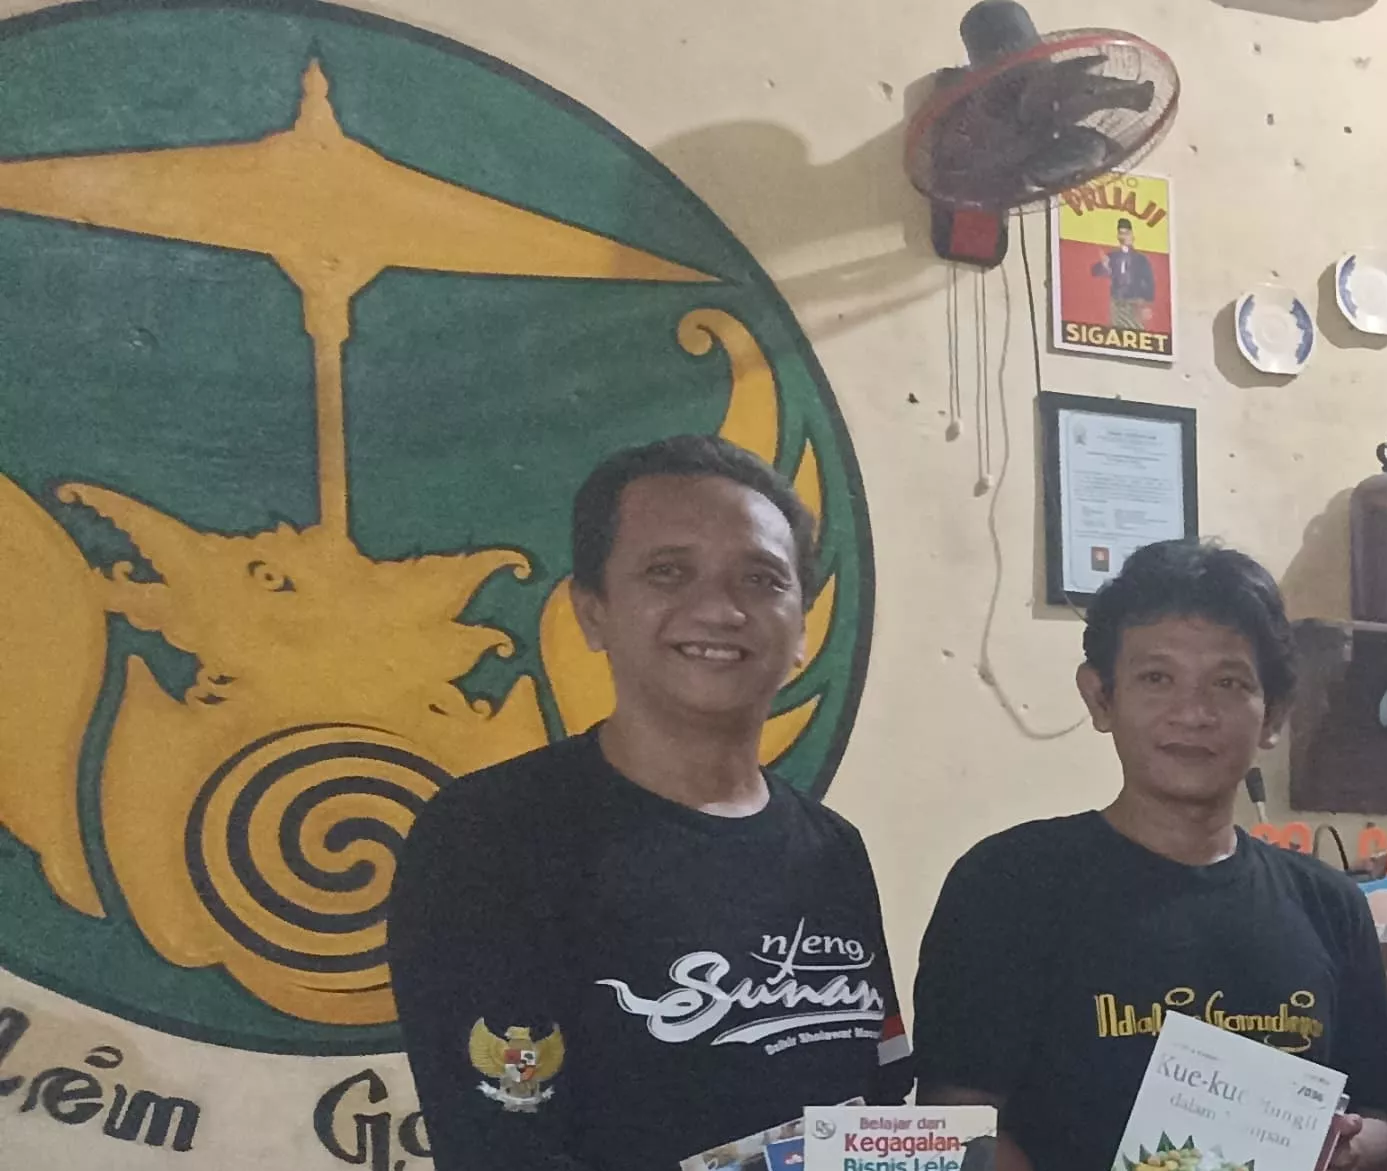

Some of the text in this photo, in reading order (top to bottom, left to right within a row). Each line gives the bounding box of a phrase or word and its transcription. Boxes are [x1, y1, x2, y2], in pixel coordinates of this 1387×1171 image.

[1066, 323, 1169, 353] SIGARET
[1170, 1092, 1216, 1121] dalam
[859, 1117, 946, 1133] Belajar dari
[844, 1132, 961, 1158] Kegagalan
